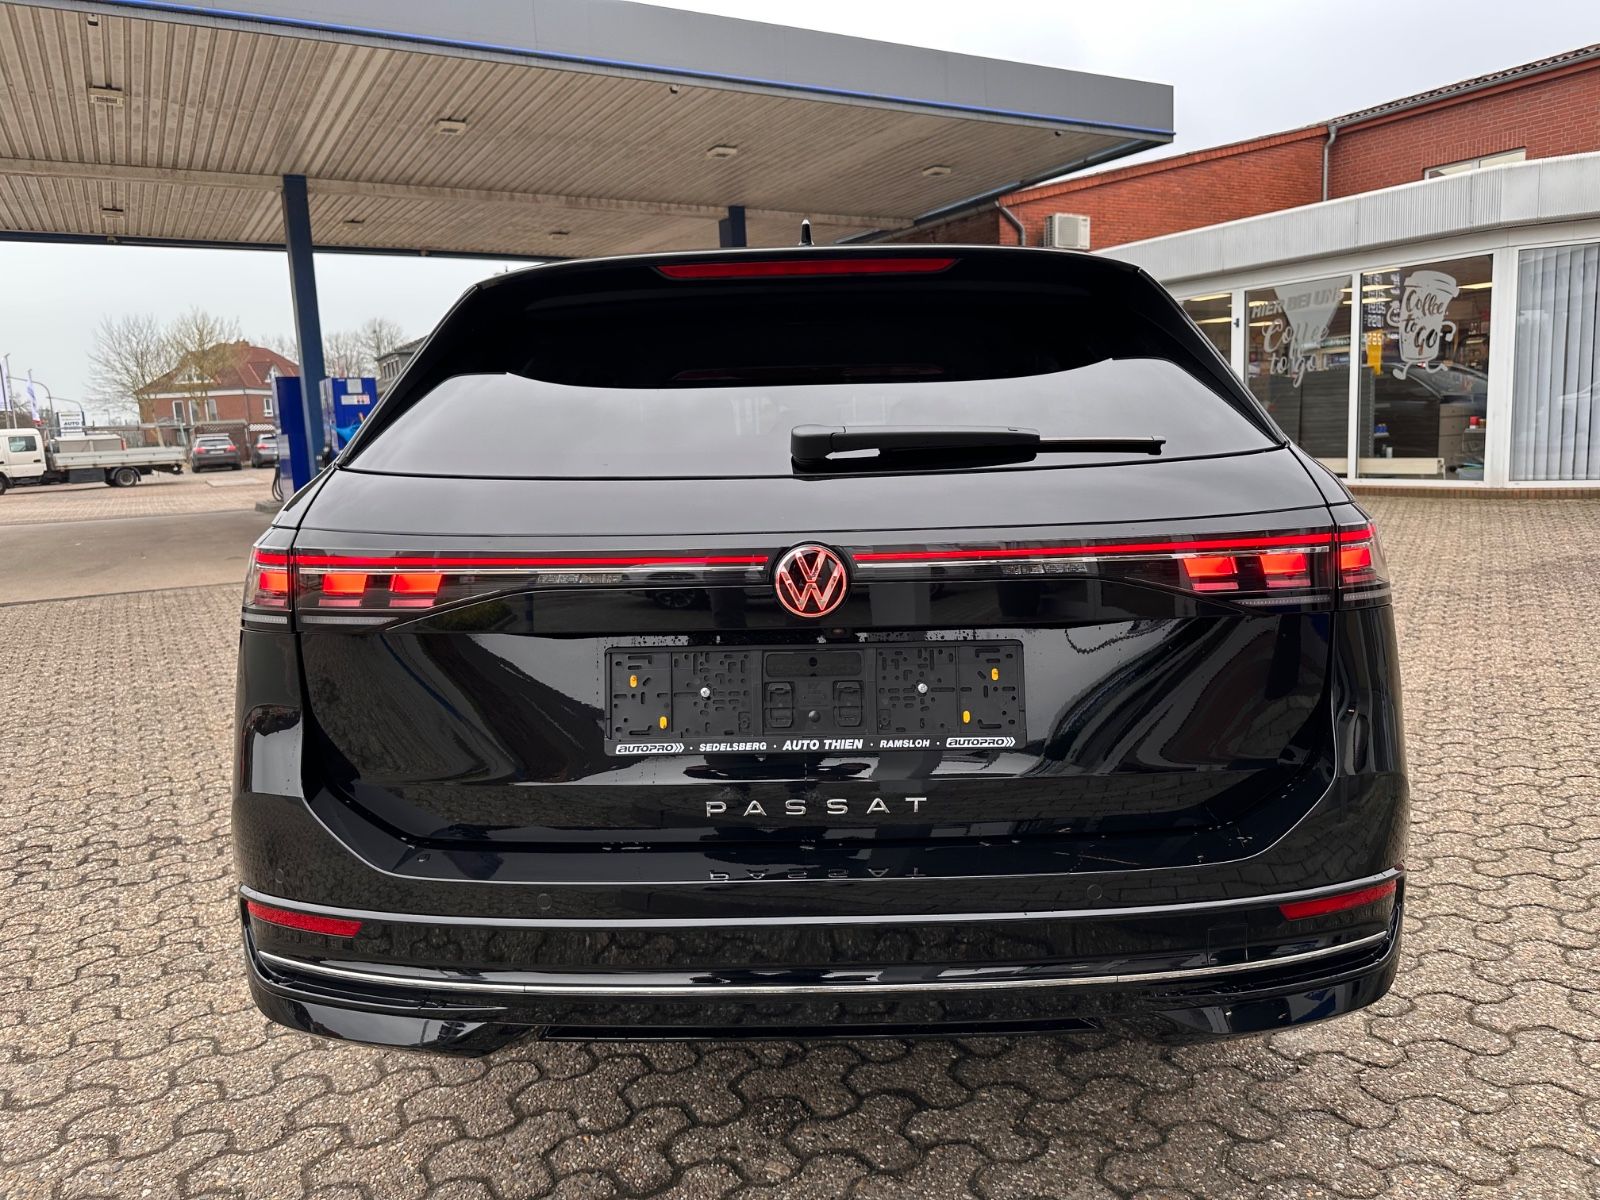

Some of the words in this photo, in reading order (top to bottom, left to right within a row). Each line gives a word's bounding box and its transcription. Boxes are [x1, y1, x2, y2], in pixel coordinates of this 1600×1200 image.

[1405, 289, 1444, 316] Coffee
[1401, 314, 1418, 334] to
[1268, 352, 1288, 375] to
[776, 545, 847, 617] VW
[699, 742, 767, 751] SEDELSBERG
[782, 739, 820, 751] AUTO
[824, 738, 864, 750] THIEN
[879, 739, 931, 748] RAMSLOH
[706, 797, 927, 817] PASSAT
